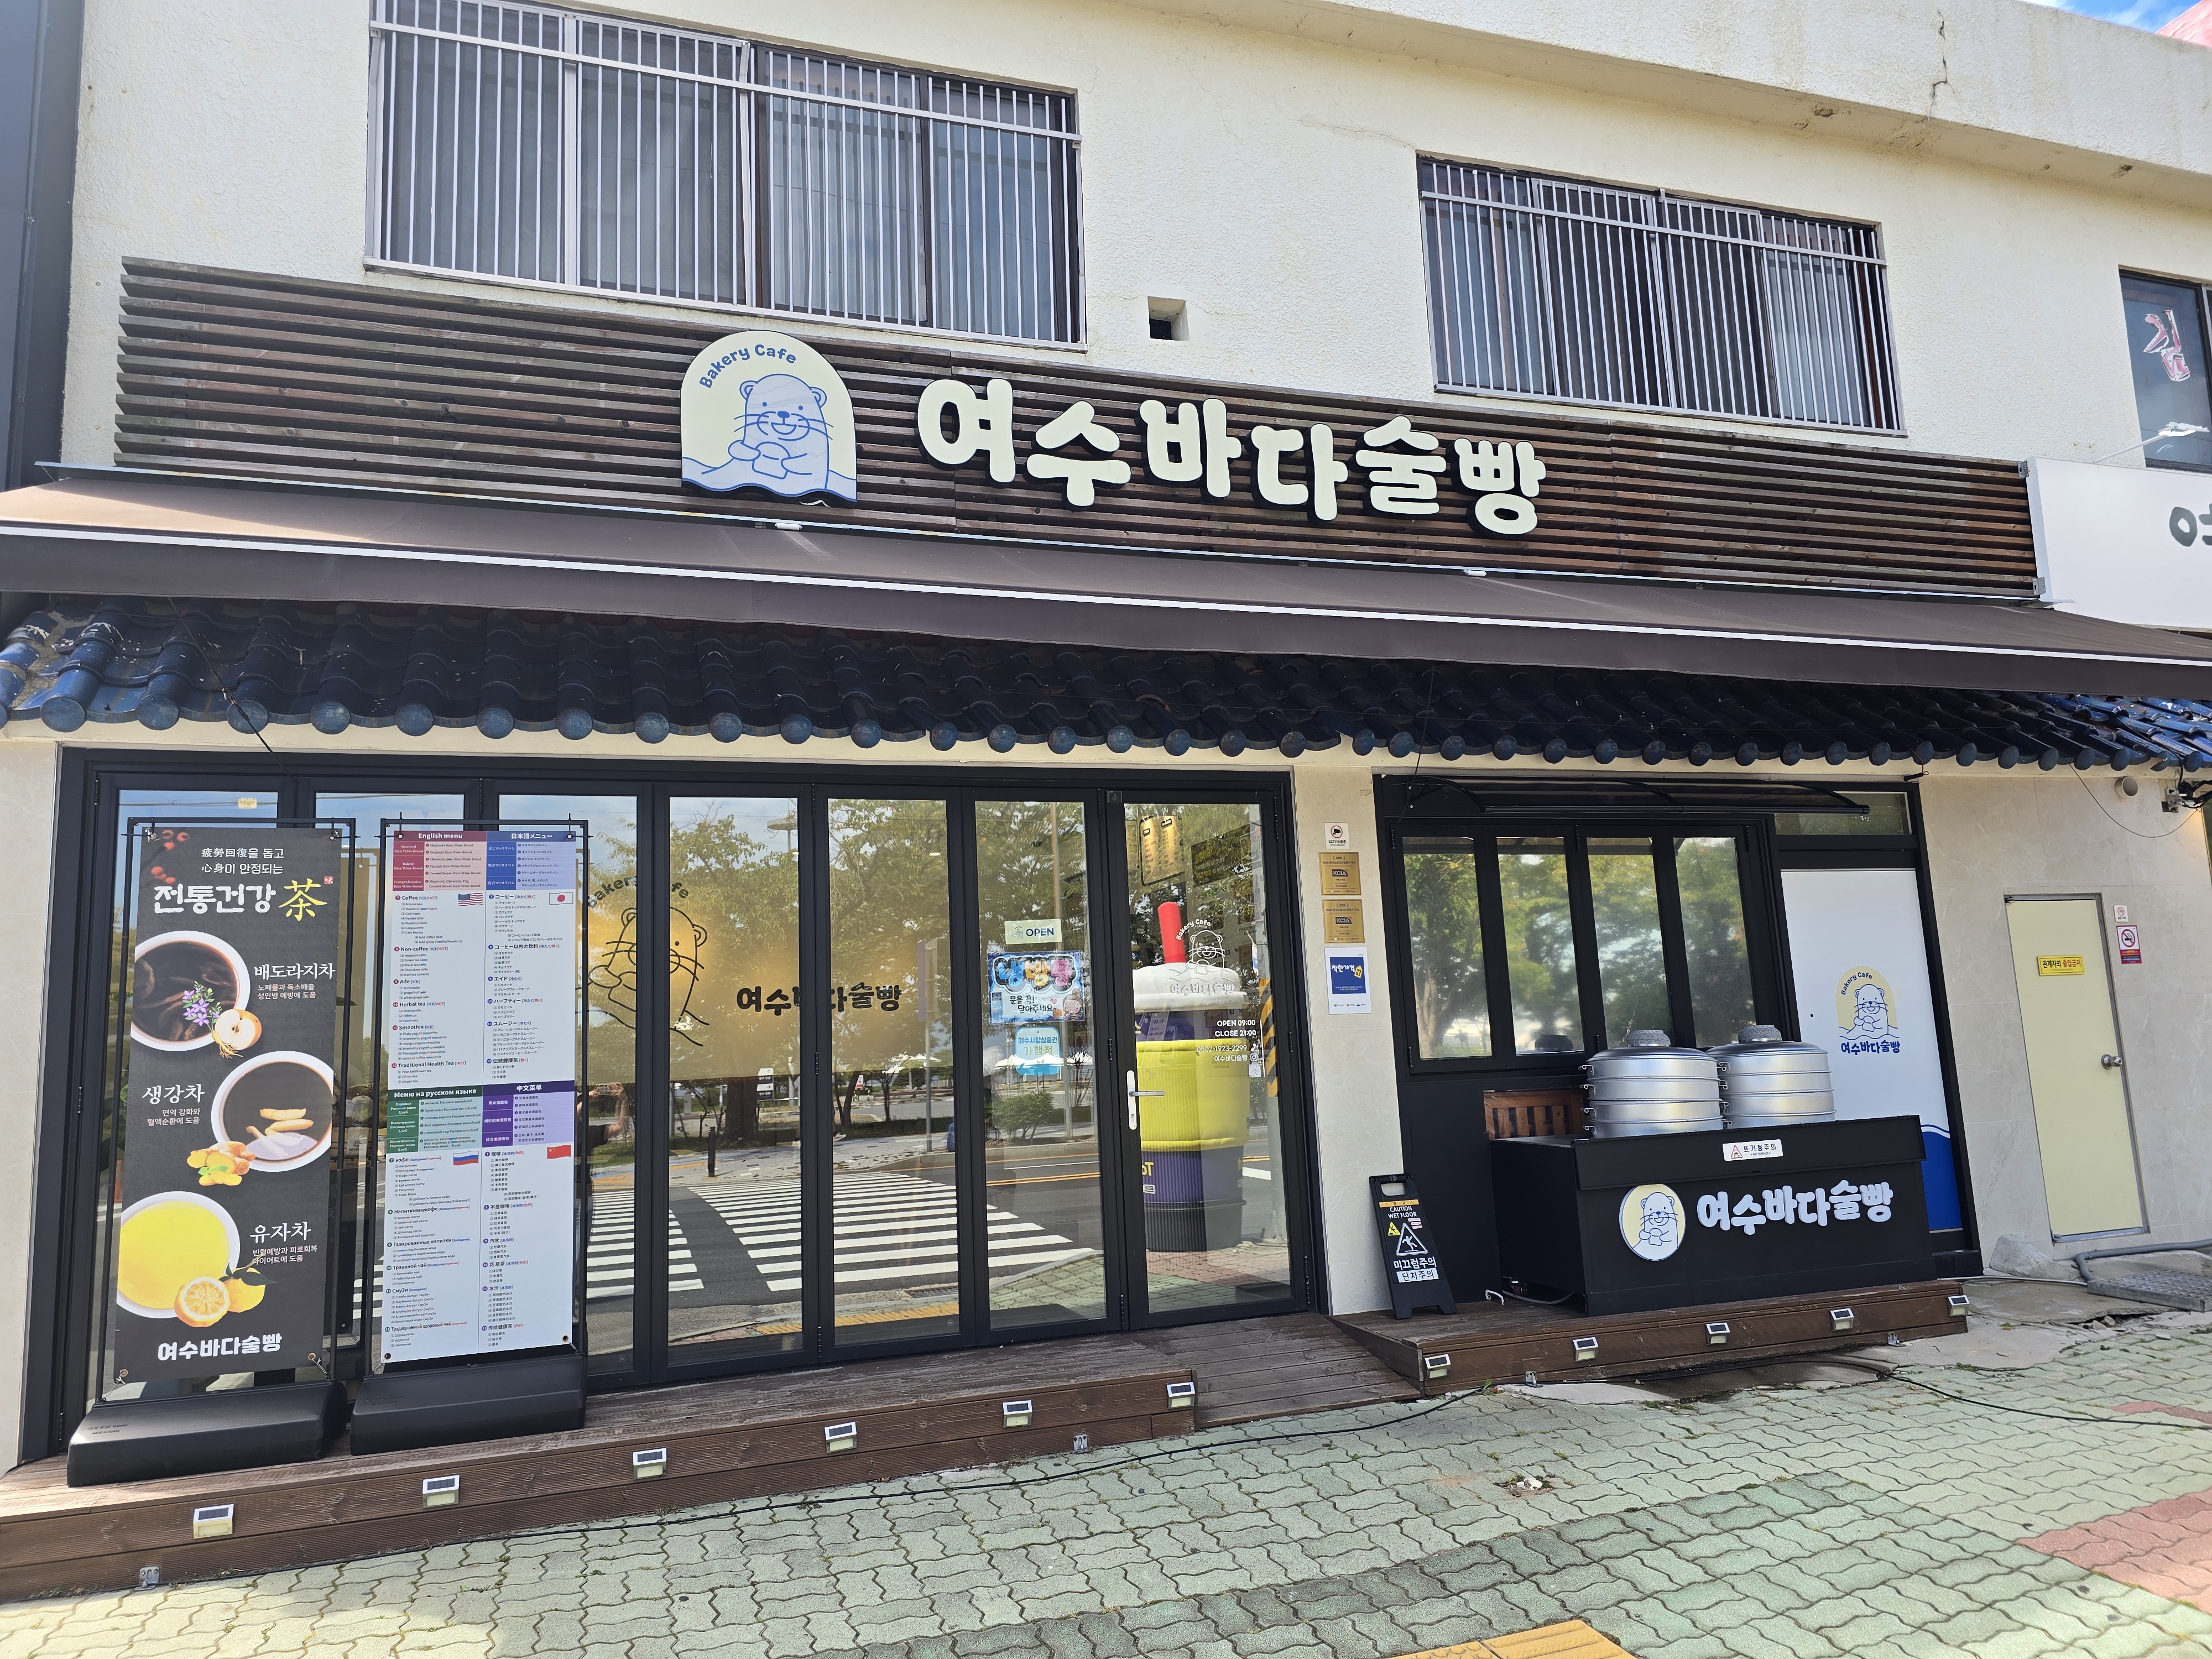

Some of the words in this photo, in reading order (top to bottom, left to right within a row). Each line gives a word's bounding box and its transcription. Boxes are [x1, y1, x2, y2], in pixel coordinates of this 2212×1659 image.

[699, 347, 750, 389] Bakery
[754, 344, 797, 364] Cafe
[917, 377, 1546, 535] 여수바다술빵
[201, 847, 259, 859] 疲勞回復을
[263, 848, 284, 859] 돕고
[201, 863, 236, 874] 心身이
[239, 863, 283, 875] 안정되는
[671, 881, 689, 899] fe
[153, 883, 276, 914] 전통건강
[278, 878, 327, 921] 茶
[1025, 927, 1054, 937] OPEN
[1176, 920, 1194, 941] Bakery
[1195, 919, 1212, 927] Cafe
[1331, 964, 1355, 973] 착한가격
[2062, 959, 2081, 968] 출입금지
[253, 963, 336, 980] 배도라지차
[287, 983, 315, 991] 독소배출
[1170, 982, 1235, 996] 여수바다술빵
[1841, 974, 1857, 995] Bakery
[1010, 995, 1023, 1004] 문을
[1018, 1004, 1053, 1014] 닫아주세요
[1024, 1046, 1052, 1056] 가맹점
[1197, 1045, 1247, 1053] 0502-1923-2299
[1841, 1040, 1900, 1056] 여수바다술빵
[142, 1083, 205, 1105] 생강차
[162, 1109, 177, 1117] 면역
[178, 1108, 201, 1117] 강화와
[147, 1118, 184, 1126] 혈액순환에
[185, 1116, 200, 1124] 도움
[1697, 1180, 1893, 1235] 여수바다술빵
[249, 1221, 311, 1244] 유자차
[252, 1246, 288, 1256] 빈혈예방과
[289, 1245, 317, 1254] 피로회복
[289, 1255, 304, 1263] 도움
[1393, 1256, 1437, 1271] 미끄럼주의
[1402, 1269, 1434, 1281] 단차주의
[158, 1333, 283, 1361] 여수바다술빵
